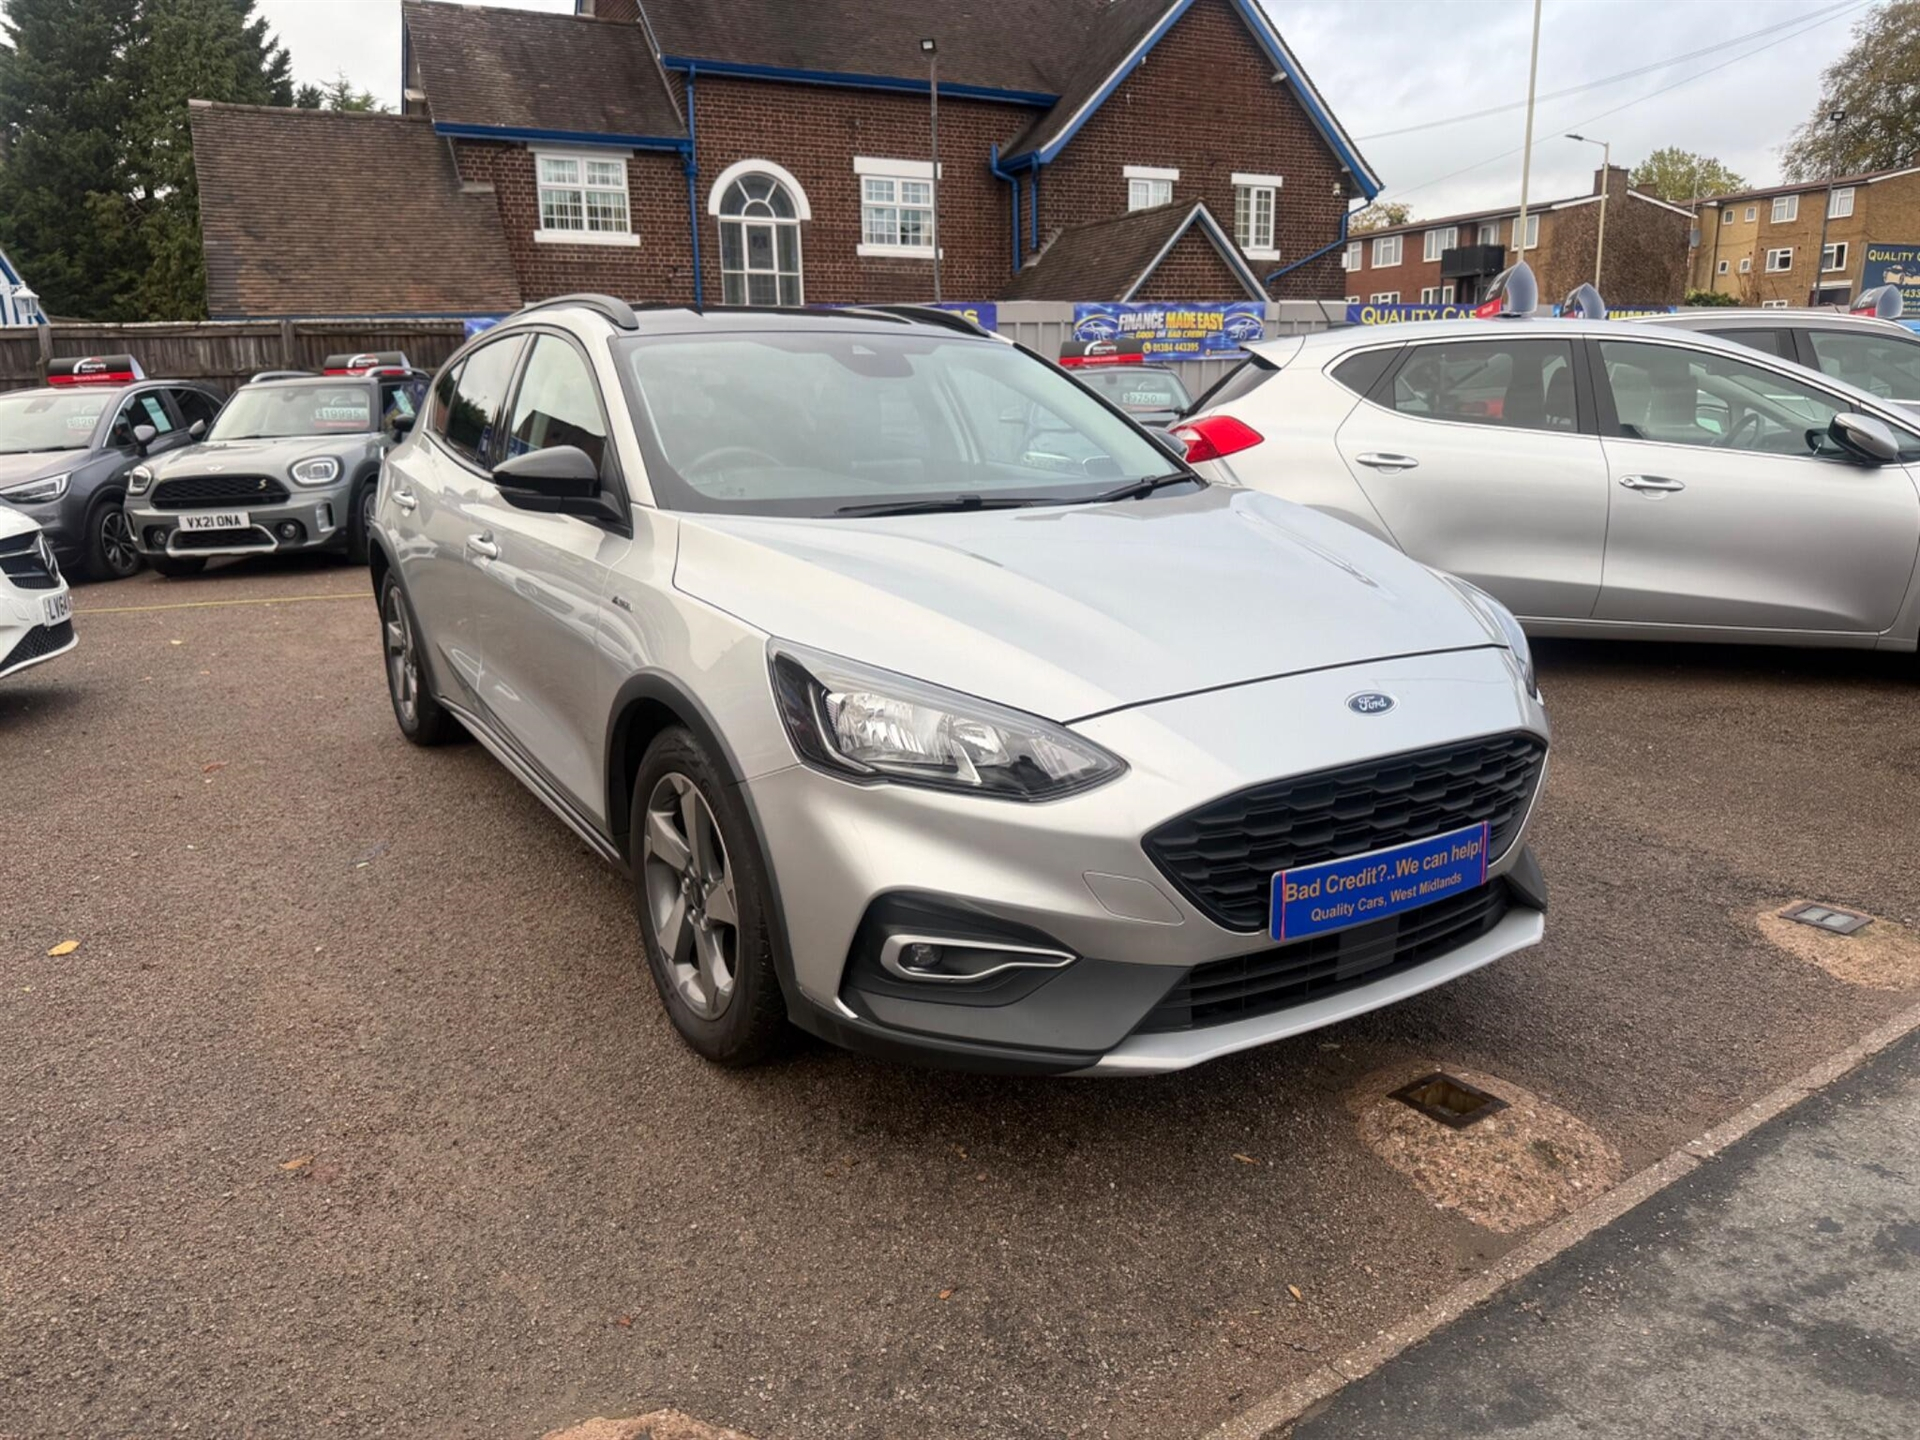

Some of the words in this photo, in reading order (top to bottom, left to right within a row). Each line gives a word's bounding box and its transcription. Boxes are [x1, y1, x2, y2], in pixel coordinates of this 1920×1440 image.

[1868, 249, 1915, 261] QUALITY
[1118, 312, 1164, 331] FINANCE
[1165, 312, 1197, 329] MADE
[1197, 312, 1224, 330] EASY
[1360, 306, 1438, 326] QUALITY
[1136, 331, 1155, 339] GOOD
[1167, 330, 1182, 338] BAD
[1182, 330, 1208, 338] CREDIT
[186, 515, 215, 529] VX21
[216, 514, 242, 528] ONA
[1358, 696, 1387, 711] Ford
[1285, 878, 1321, 903] Bad
[1423, 852, 1448, 870] can
[1451, 836, 1483, 863] help!
[1311, 902, 1355, 922] Quality
[1357, 894, 1388, 912] Cars,
[1390, 886, 1417, 904] West
[1419, 872, 1462, 895] Midlands
